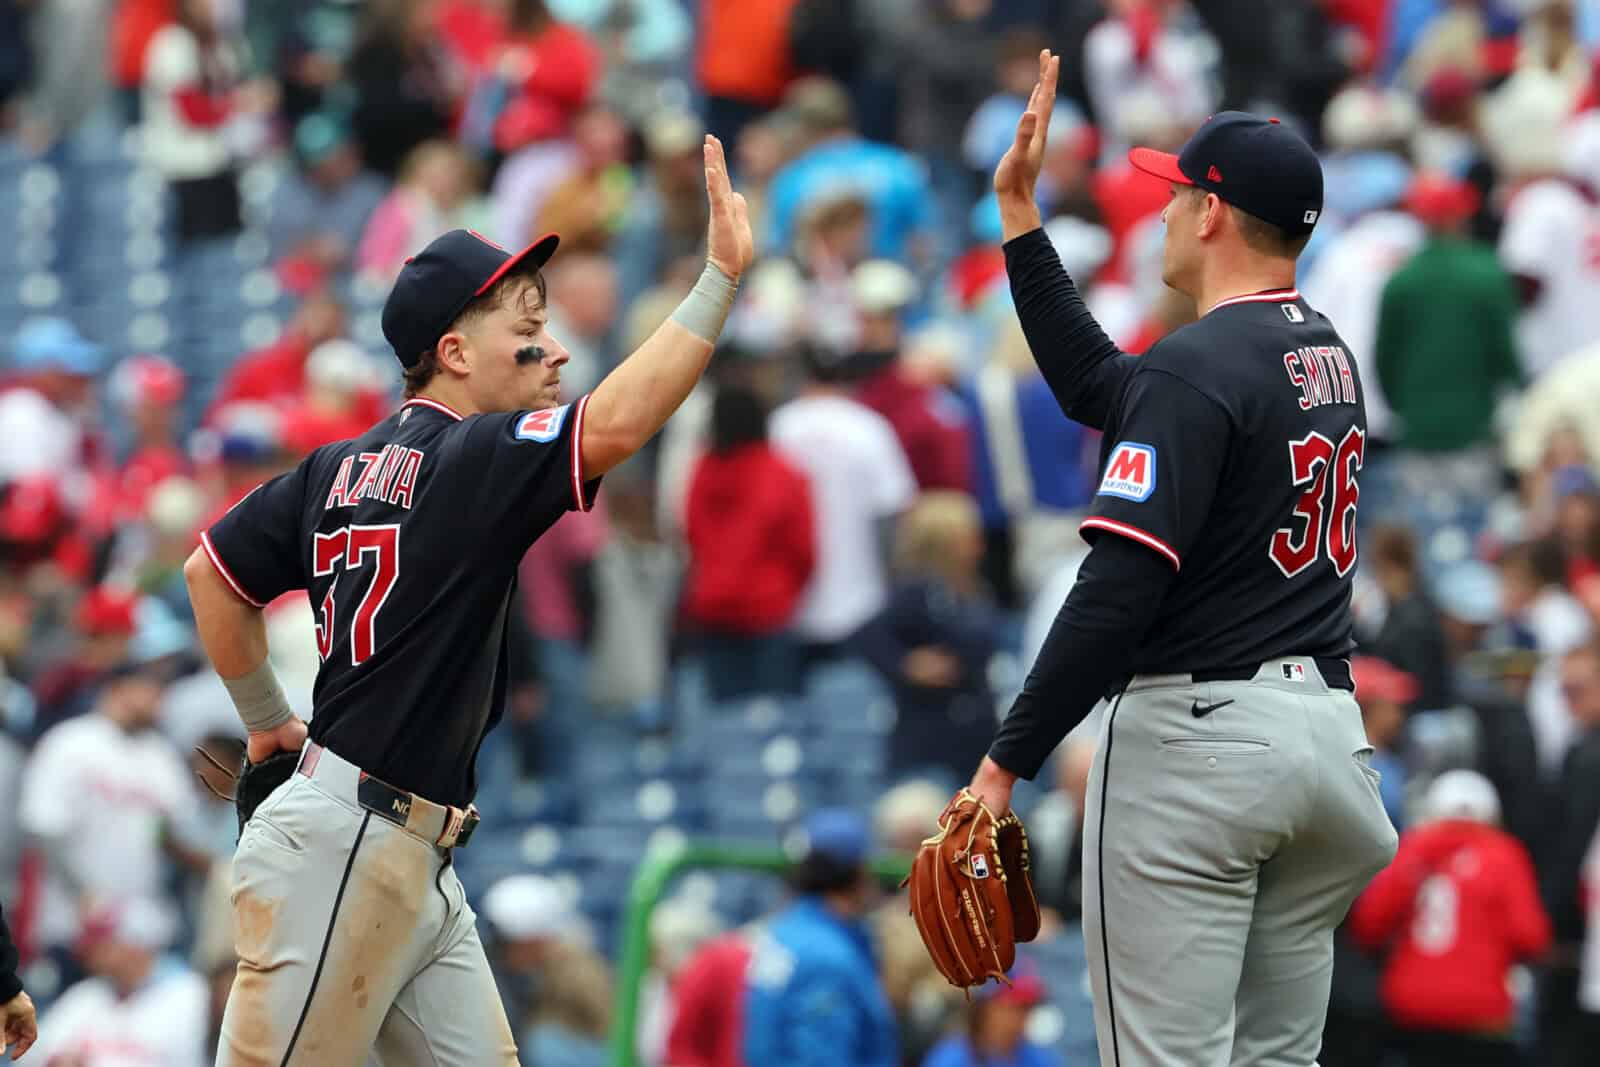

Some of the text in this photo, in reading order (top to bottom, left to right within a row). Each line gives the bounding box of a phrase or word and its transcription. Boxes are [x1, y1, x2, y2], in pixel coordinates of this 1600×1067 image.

[1284, 346, 1356, 410] SMITH
[1108, 450, 1146, 484] M
[1269, 424, 1365, 578] 36
[314, 523, 400, 666] 37
